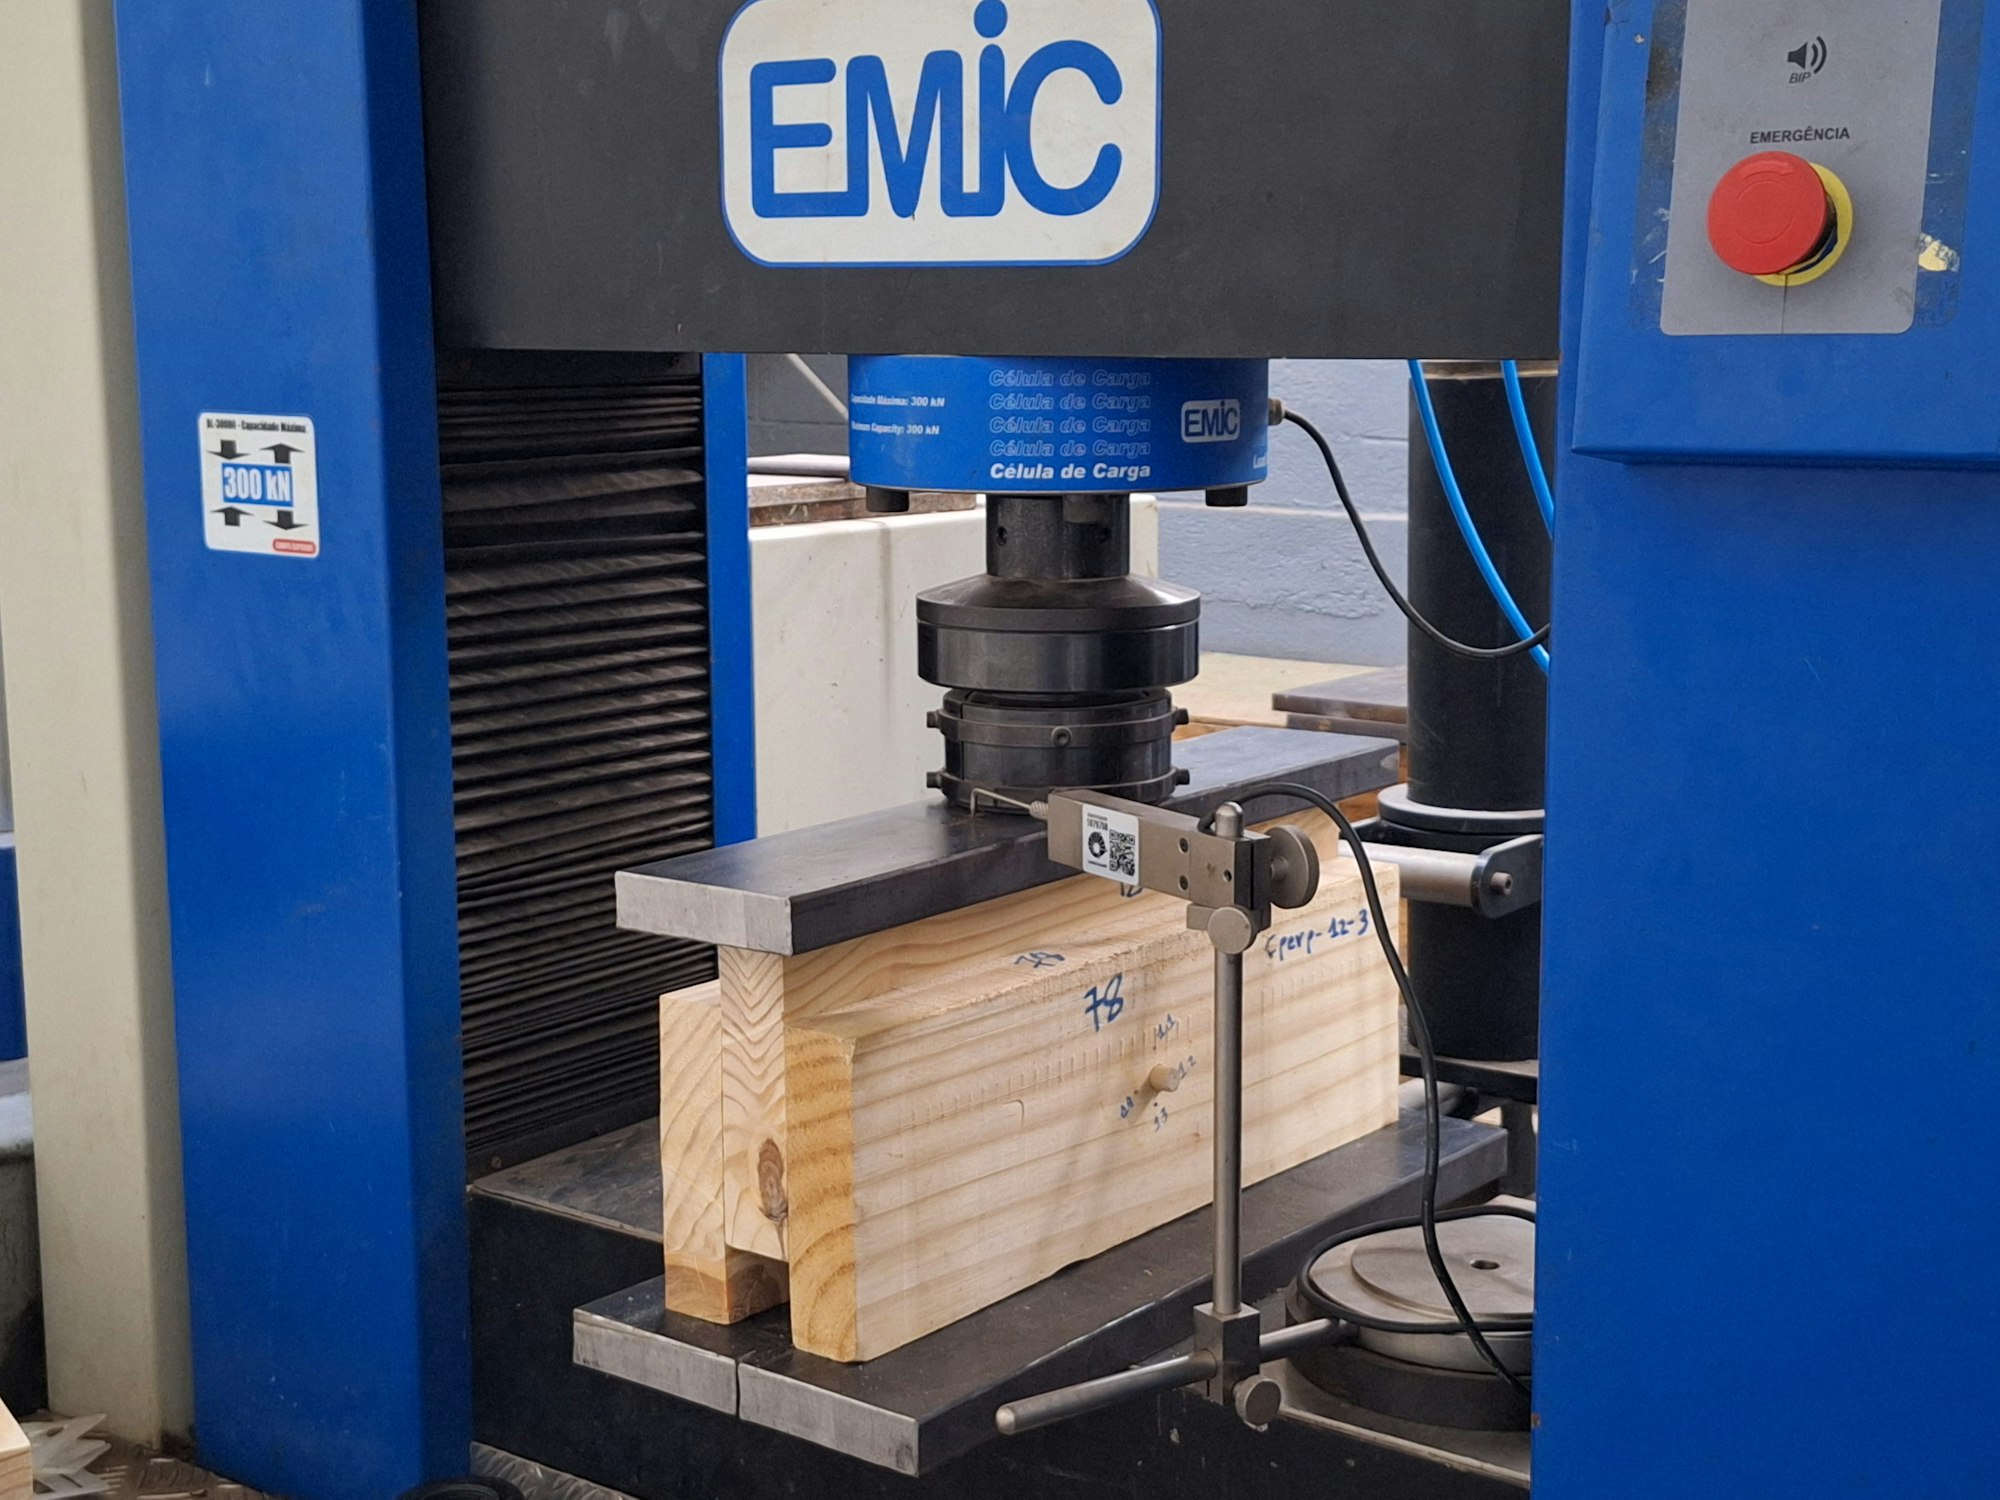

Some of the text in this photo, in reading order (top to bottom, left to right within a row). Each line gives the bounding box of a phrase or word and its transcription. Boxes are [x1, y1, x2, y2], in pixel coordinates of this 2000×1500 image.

[1789, 71, 1811, 84] BIP
[1750, 126, 1850, 144] EMERGÊNCIA
[989, 369, 1151, 389] Célula de Carga
[910, 396, 928, 407] 300
[930, 397, 945, 408] kN
[989, 393, 1151, 412] Célula de Carga
[906, 424, 924, 435] 300
[925, 425, 940, 436] kN
[989, 416, 1151, 436] Célula de Carga
[989, 439, 1151, 459] Célula de Carga
[989, 462, 1151, 481] Célula de Carga
[223, 466, 291, 502] 300 kN
[1083, 971, 1124, 1032] 78
